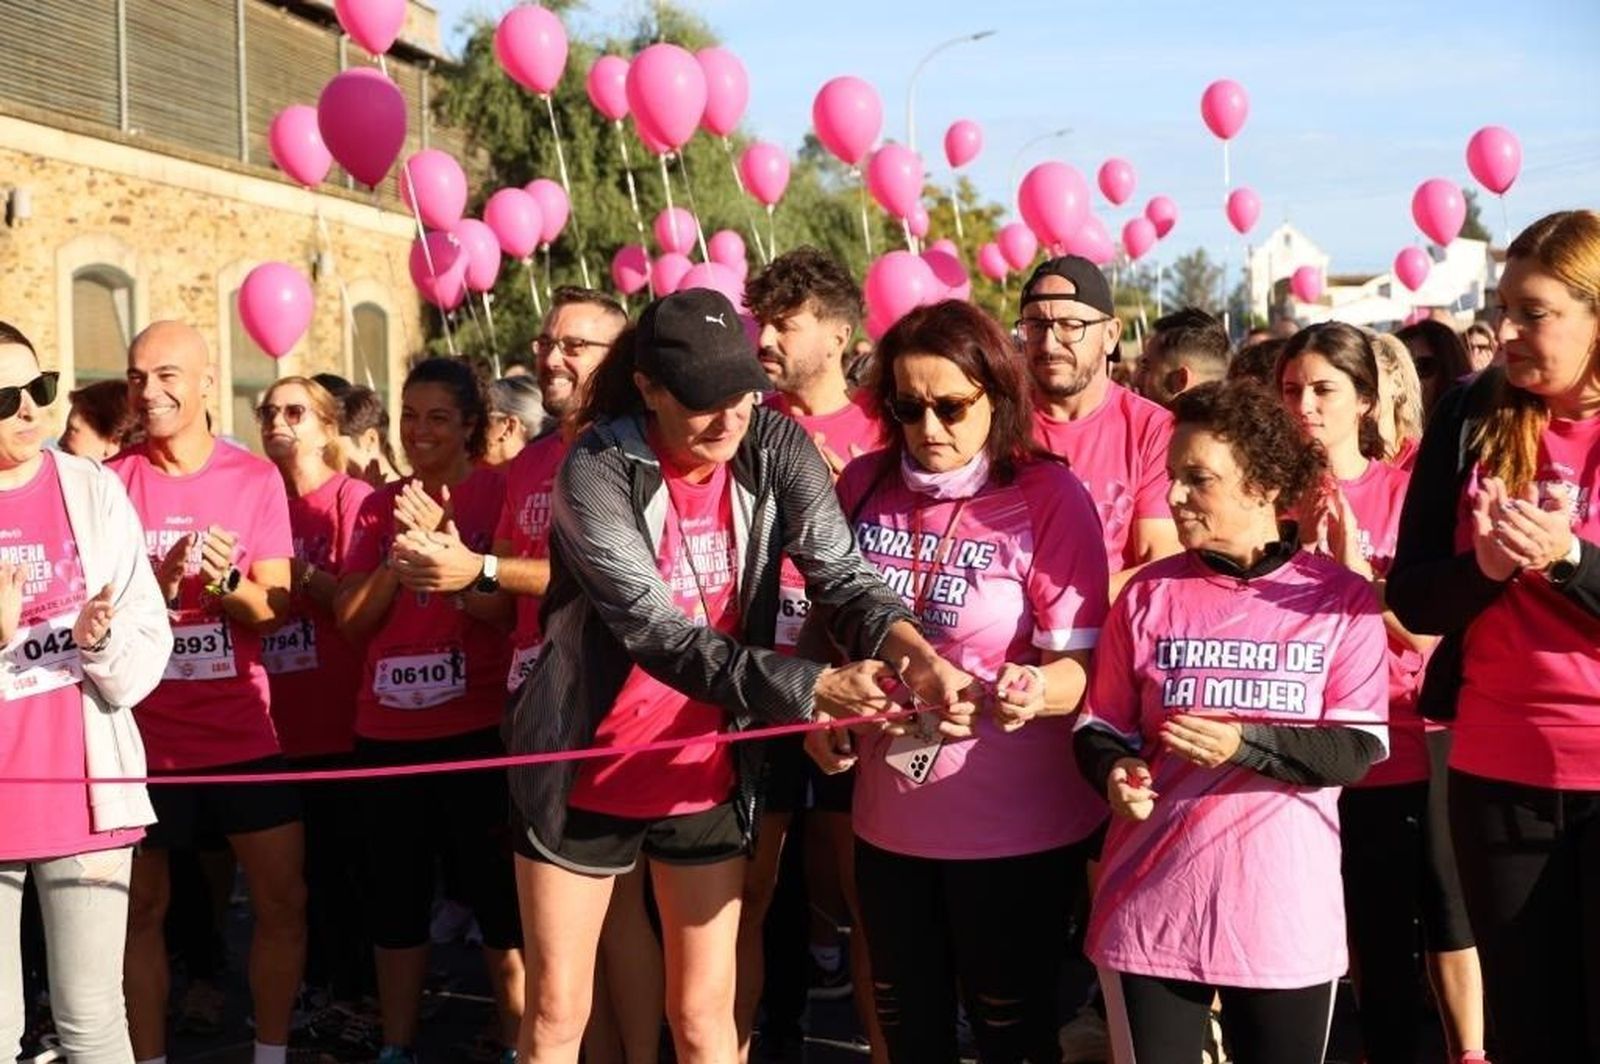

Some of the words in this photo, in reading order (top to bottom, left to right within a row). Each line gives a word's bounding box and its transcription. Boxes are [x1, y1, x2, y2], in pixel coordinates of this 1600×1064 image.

[955, 537, 996, 571] DE
[23, 628, 78, 661] 042
[173, 635, 217, 655] 693
[1157, 638, 1279, 671] CARRERA
[1284, 640, 1325, 673] DE
[391, 664, 446, 685] 0610
[1162, 677, 1197, 707] LA
[1202, 677, 1306, 713] MUJER
